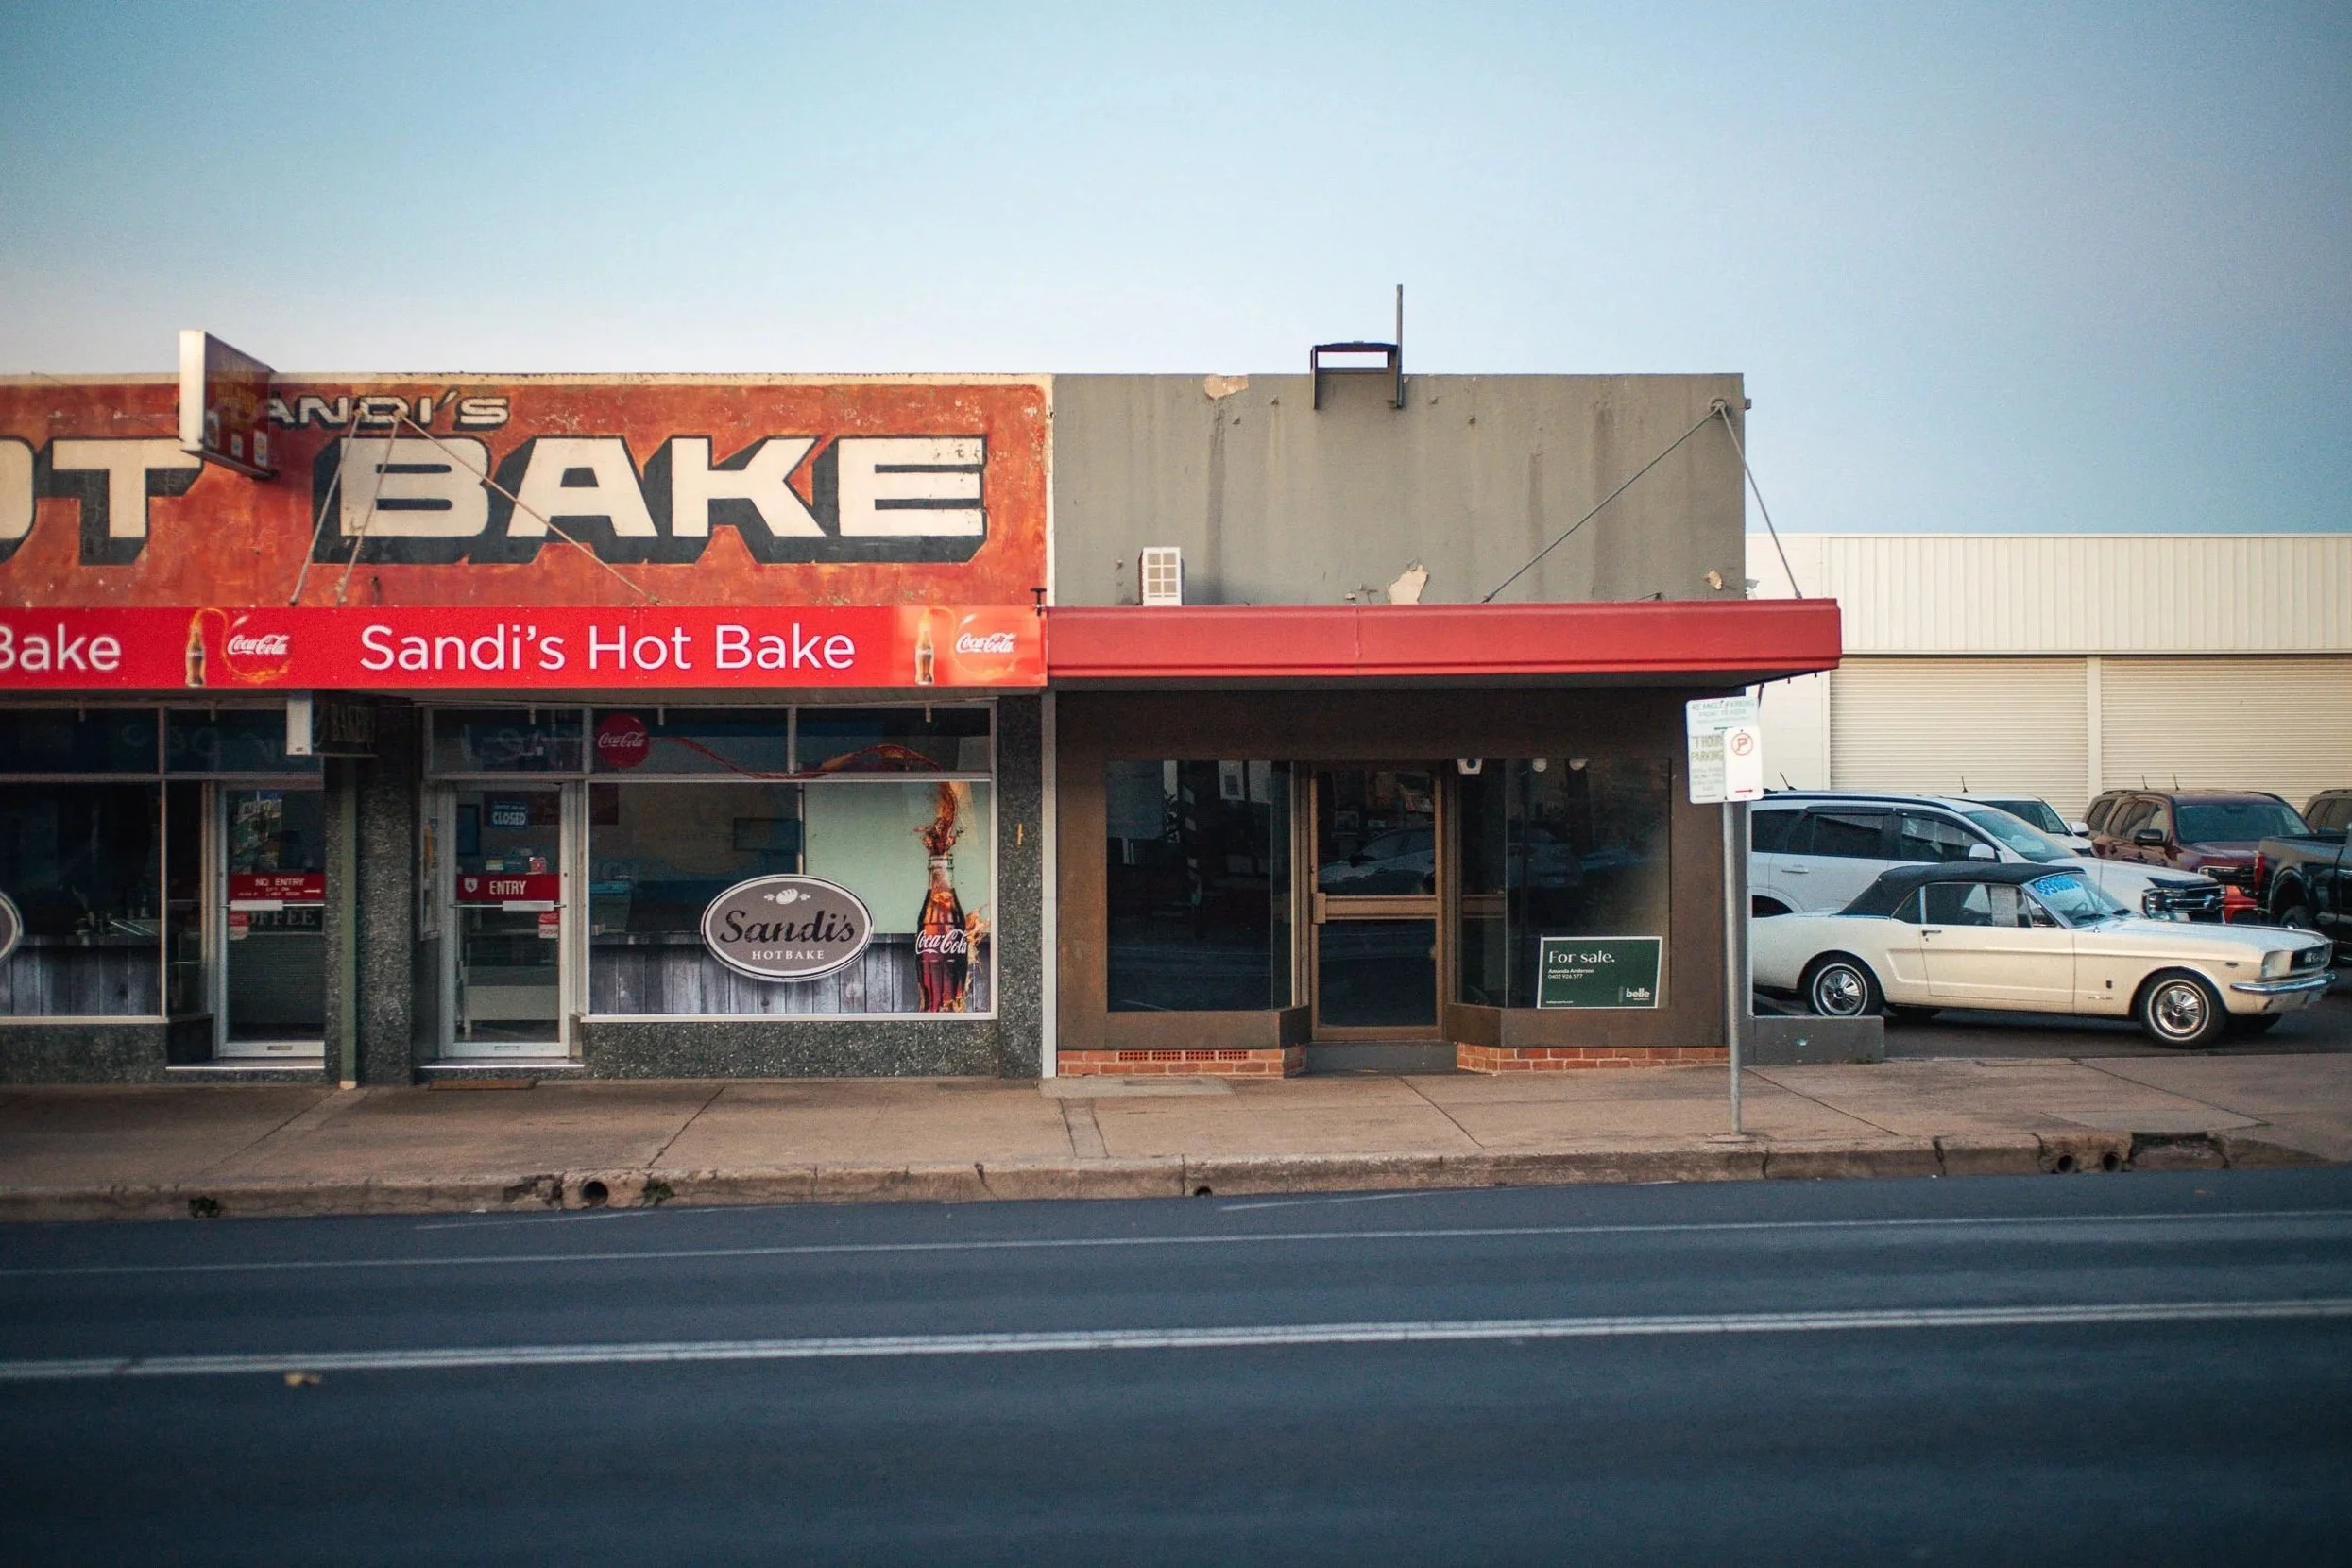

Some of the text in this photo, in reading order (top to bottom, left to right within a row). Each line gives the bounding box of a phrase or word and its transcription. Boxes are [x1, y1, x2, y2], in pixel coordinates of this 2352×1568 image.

[269, 390, 510, 428] ANDI'S
[0, 435, 987, 539] T BAKE
[360, 623, 856, 672] Sandi's Hot Bake
[492, 811, 526, 827] CLOSED
[255, 878, 305, 887] NO ENTRY
[489, 880, 527, 895] ENTRY
[720, 909, 856, 944] Sandi's
[752, 950, 826, 961] HOTBAKE
[1549, 949, 1616, 963] For sale.
[1626, 987, 1650, 997] belle
